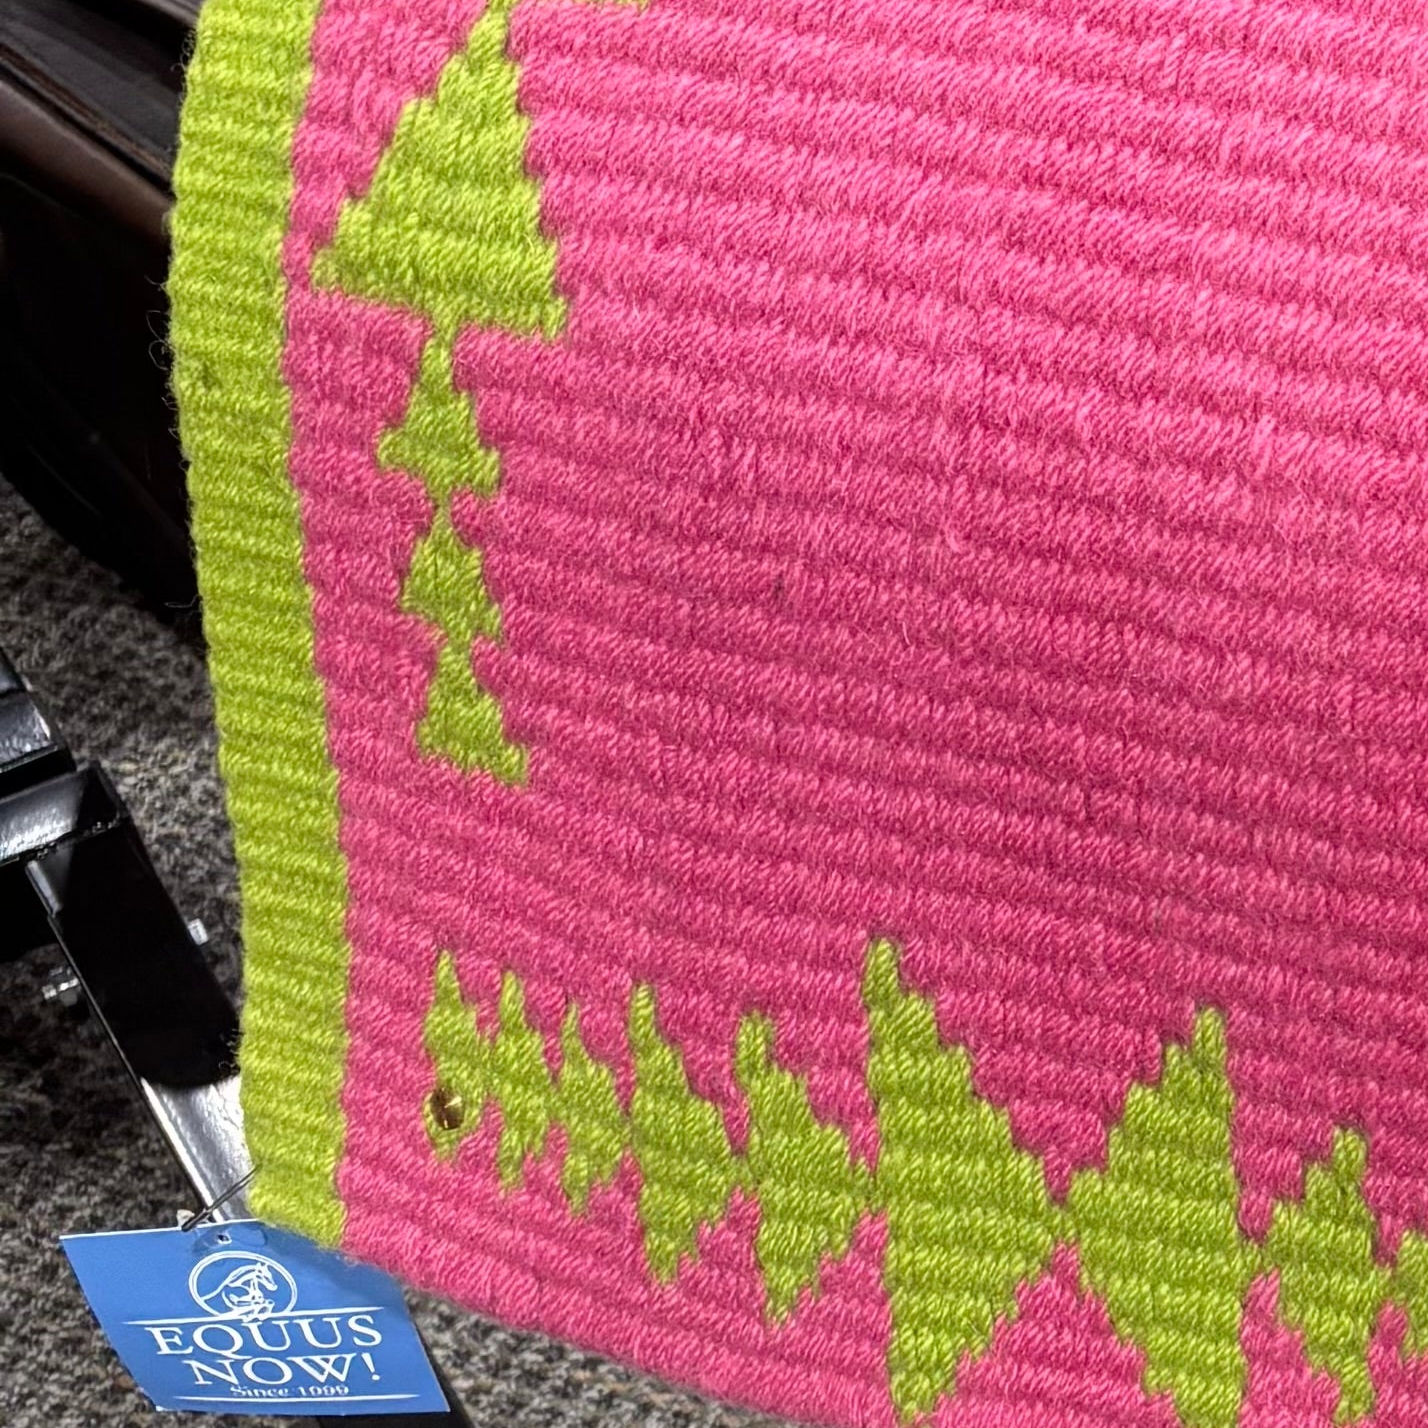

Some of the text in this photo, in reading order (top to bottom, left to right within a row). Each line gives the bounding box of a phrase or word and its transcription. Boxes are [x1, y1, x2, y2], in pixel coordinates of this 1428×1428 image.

[144, 1314, 382, 1360] EQUUS
[183, 1352, 381, 1387] NOW!
[230, 1384, 290, 1398] Since
